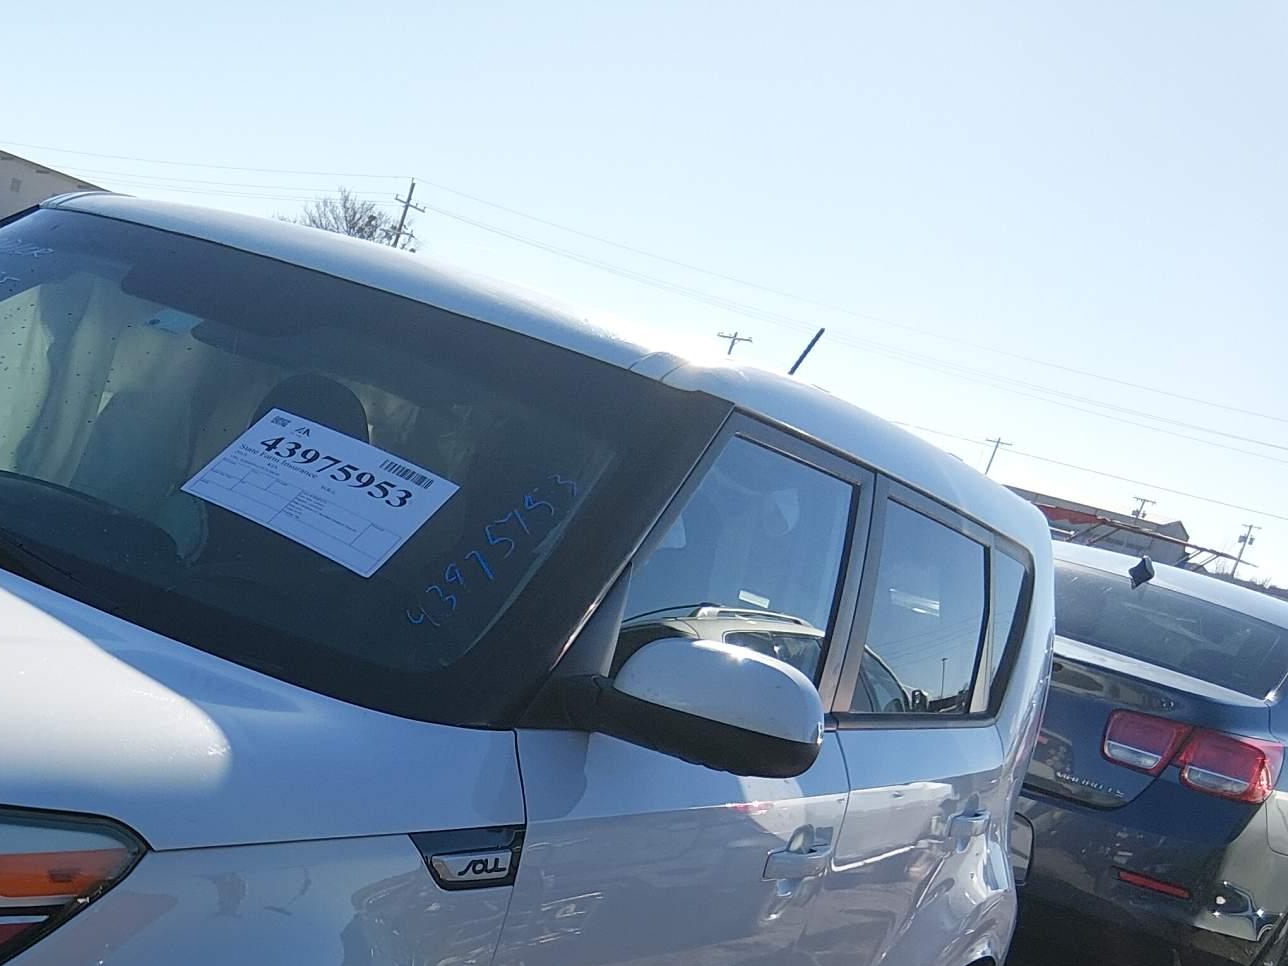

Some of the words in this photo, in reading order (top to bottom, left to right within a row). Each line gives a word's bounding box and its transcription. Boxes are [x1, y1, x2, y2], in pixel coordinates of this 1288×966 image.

[260, 436, 414, 508] 43975953
[281, 459, 319, 480] Insurance
[457, 857, 507, 877] SOUL
